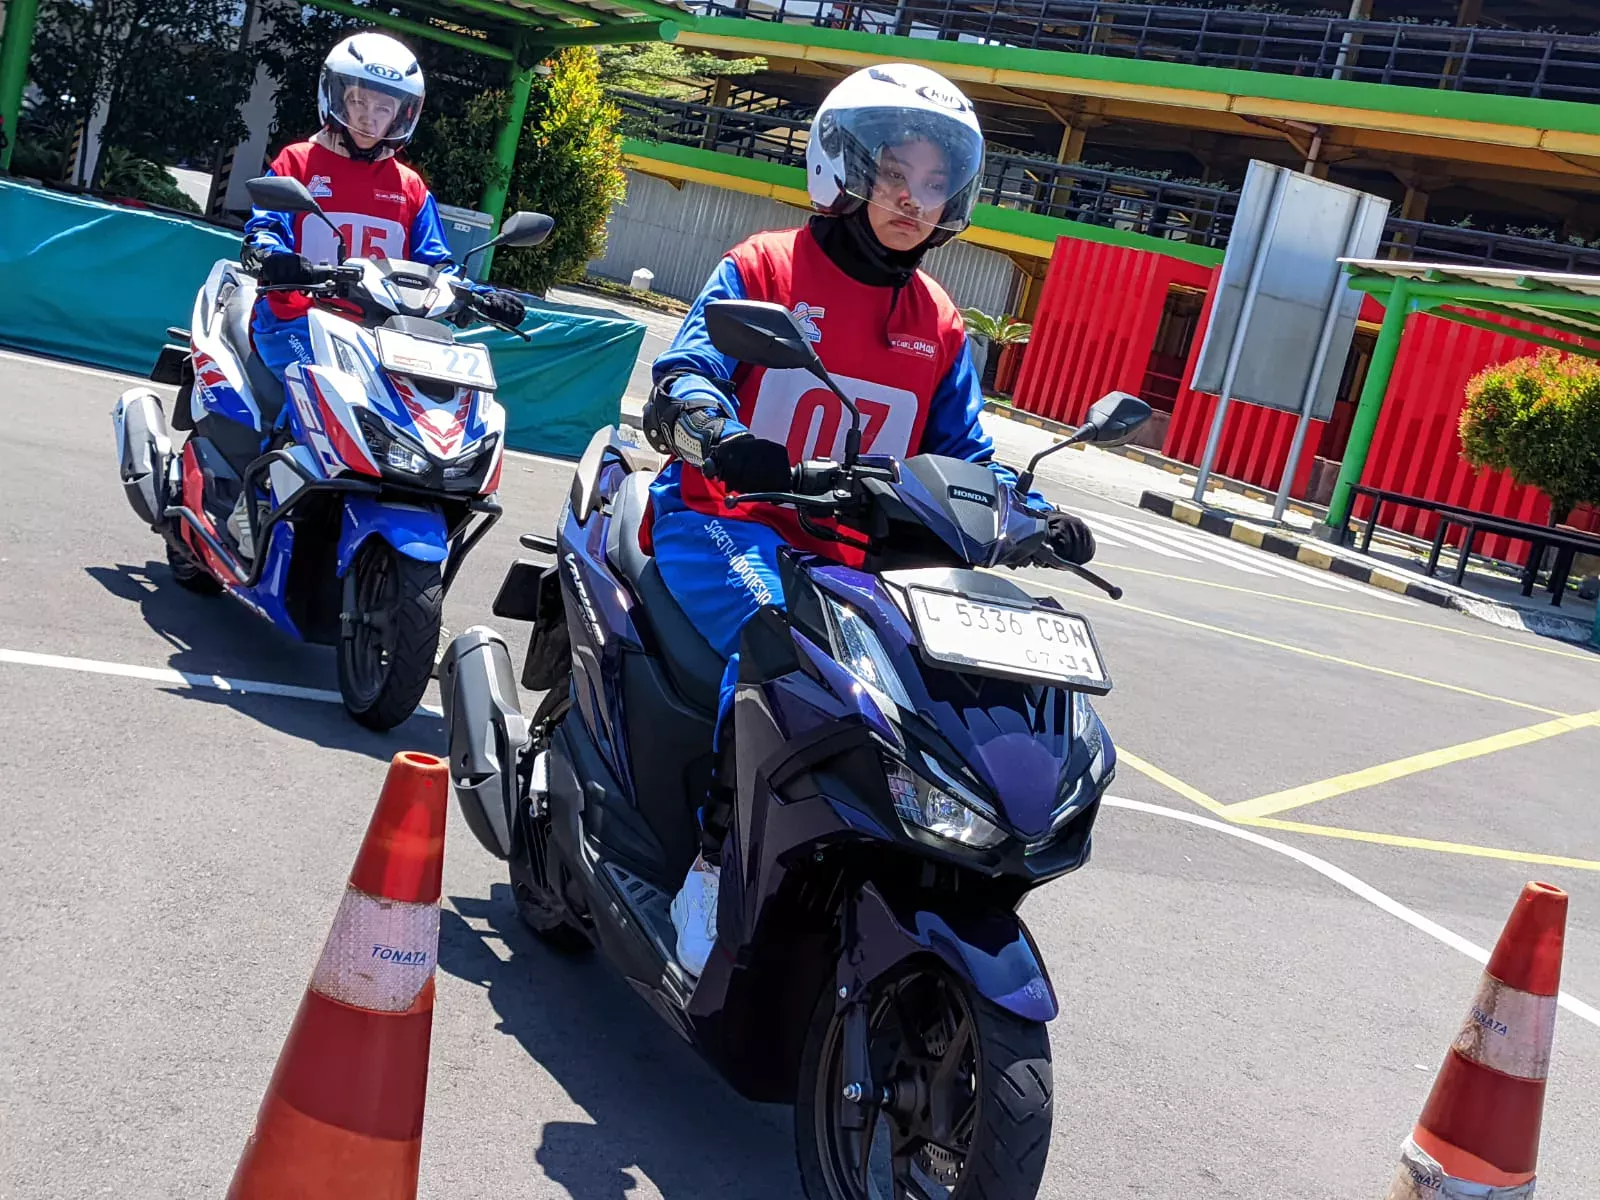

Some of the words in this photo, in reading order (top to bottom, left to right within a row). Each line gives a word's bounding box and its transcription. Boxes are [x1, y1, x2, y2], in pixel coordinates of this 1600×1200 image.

[442, 348, 482, 378] 22
[785, 387, 891, 468] 07
[952, 488, 989, 503] HONDA
[921, 596, 941, 622] L
[956, 602, 1023, 636] 5336
[1036, 616, 1088, 649] CBN
[371, 946, 427, 964] TONATA
